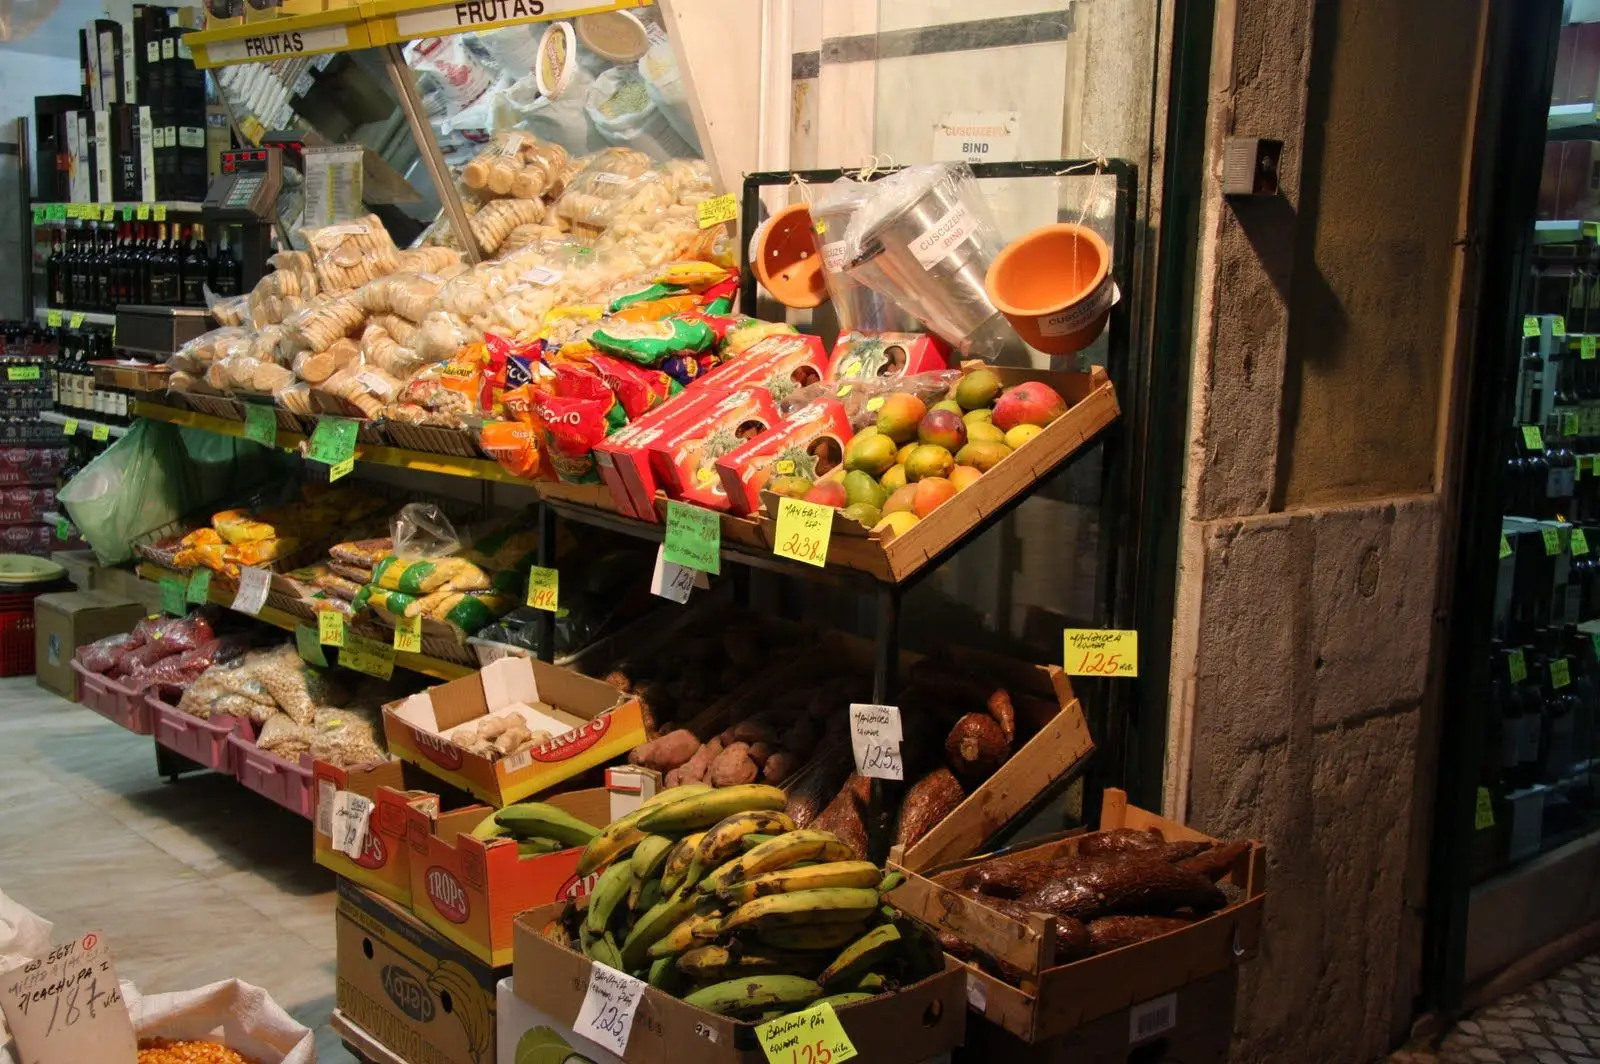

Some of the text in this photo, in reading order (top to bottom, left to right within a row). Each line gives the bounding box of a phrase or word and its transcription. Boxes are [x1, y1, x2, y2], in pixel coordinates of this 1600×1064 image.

[456, 0, 545, 26] FRUTAS
[245, 32, 304, 57] FRUTAS
[962, 142, 989, 153] BIND
[428, 871, 466, 915] TROPS
[46, 940, 77, 965] 5681
[385, 966, 433, 1023] derby
[765, 1015, 807, 1042] BANANA
